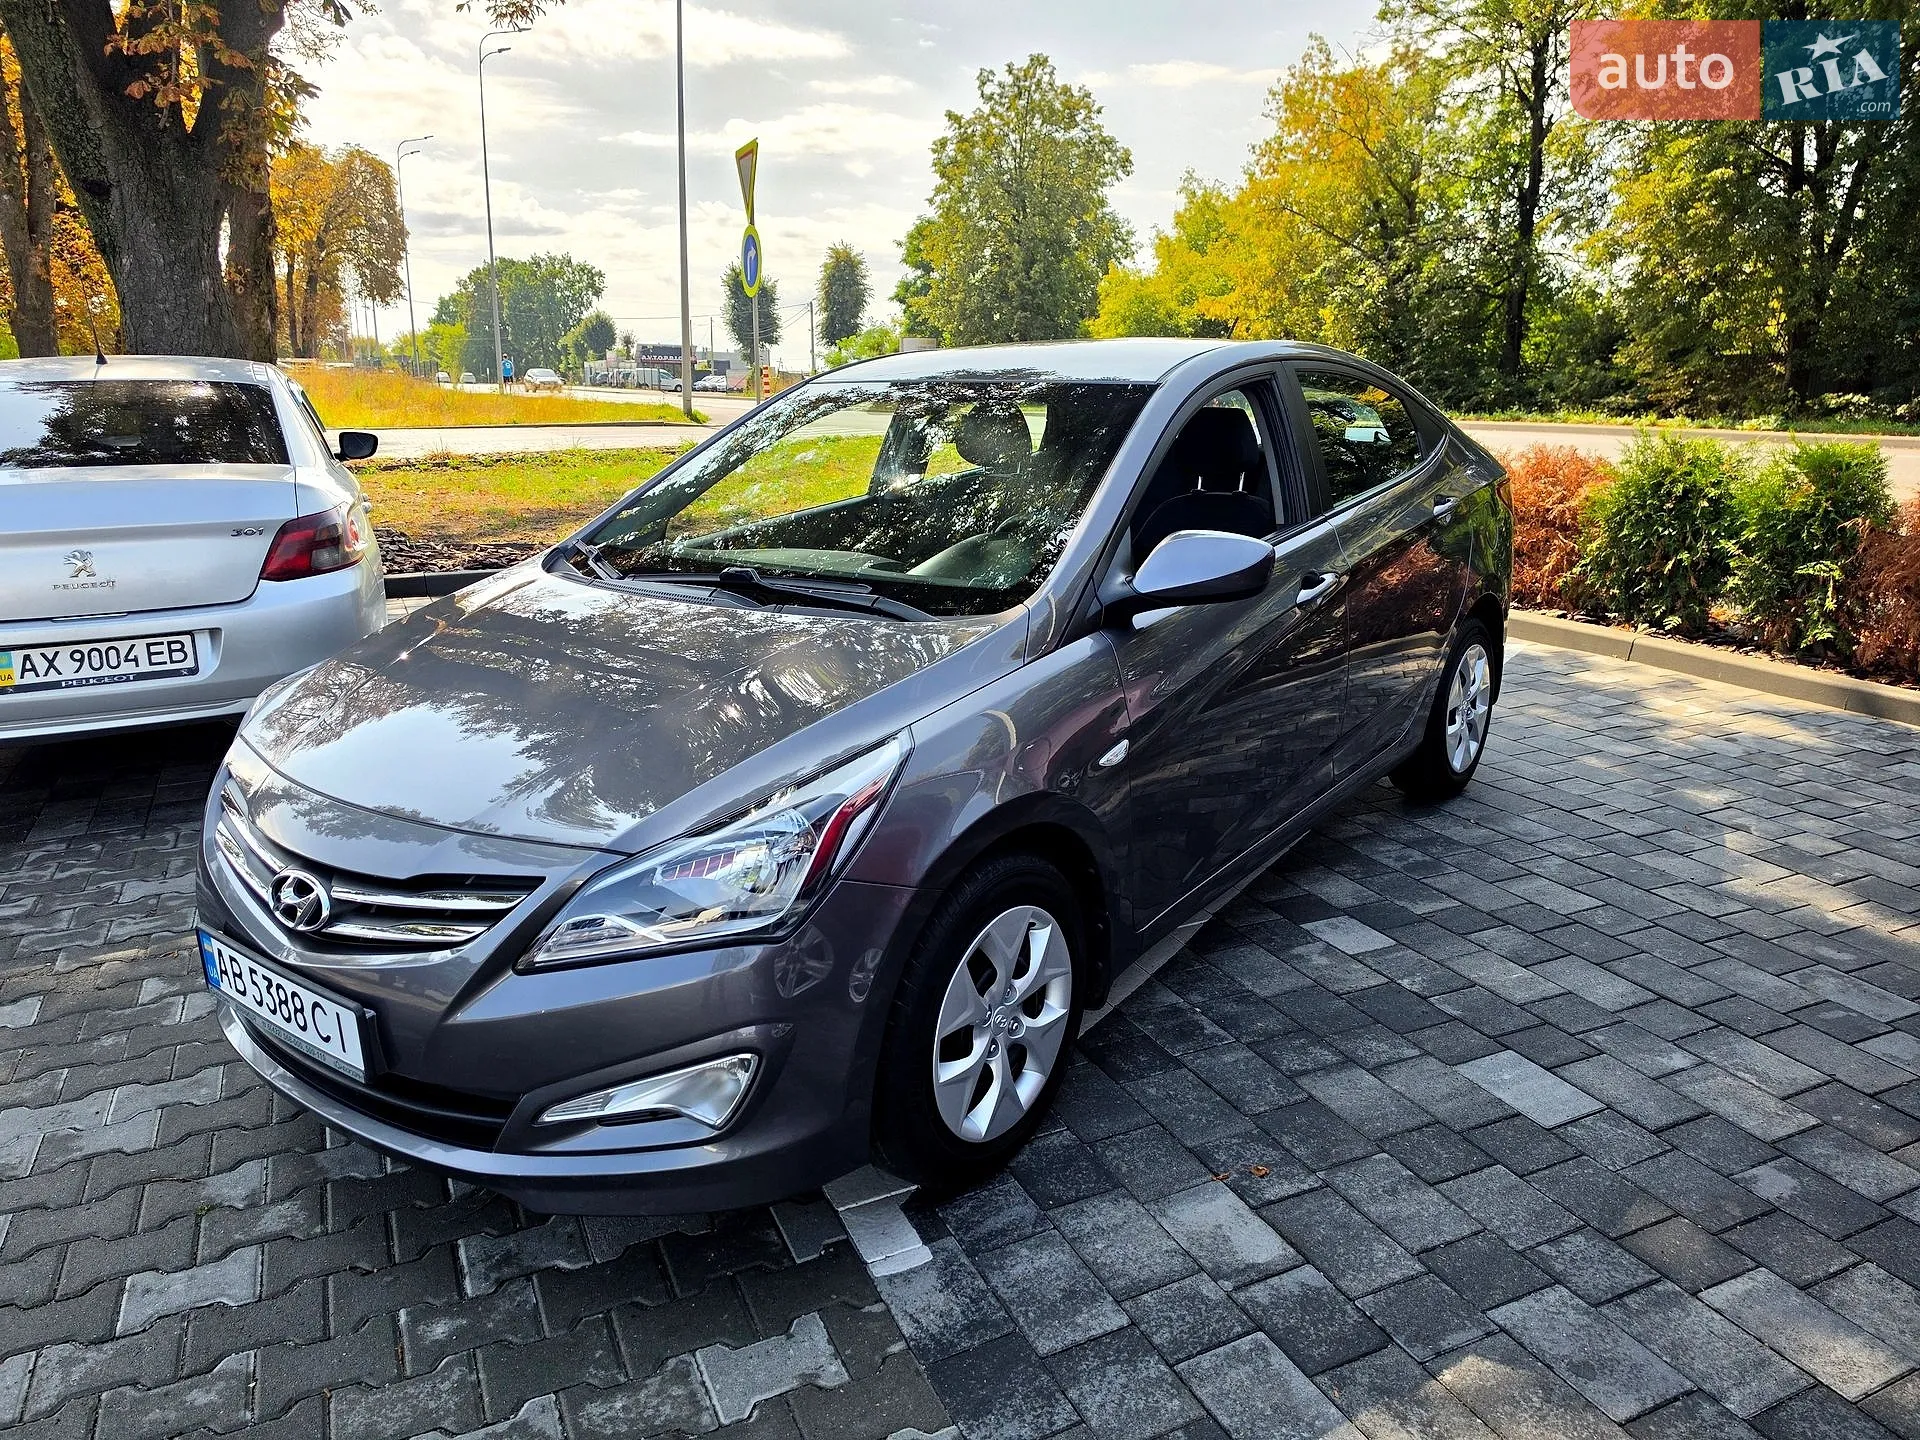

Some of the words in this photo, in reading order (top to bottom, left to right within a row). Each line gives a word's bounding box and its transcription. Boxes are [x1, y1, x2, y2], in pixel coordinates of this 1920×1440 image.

[230, 526, 264, 537] 301
[52, 580, 116, 591] PEUGEOT
[19, 650, 63, 680] AX
[69, 643, 139, 674] 9004
[146, 639, 188, 666] EB
[61, 673, 137, 687] PEUGEOT
[207, 964, 220, 980] UA
[217, 947, 247, 997] AB
[248, 965, 308, 1033] 5388
[311, 1000, 347, 1054] CI
